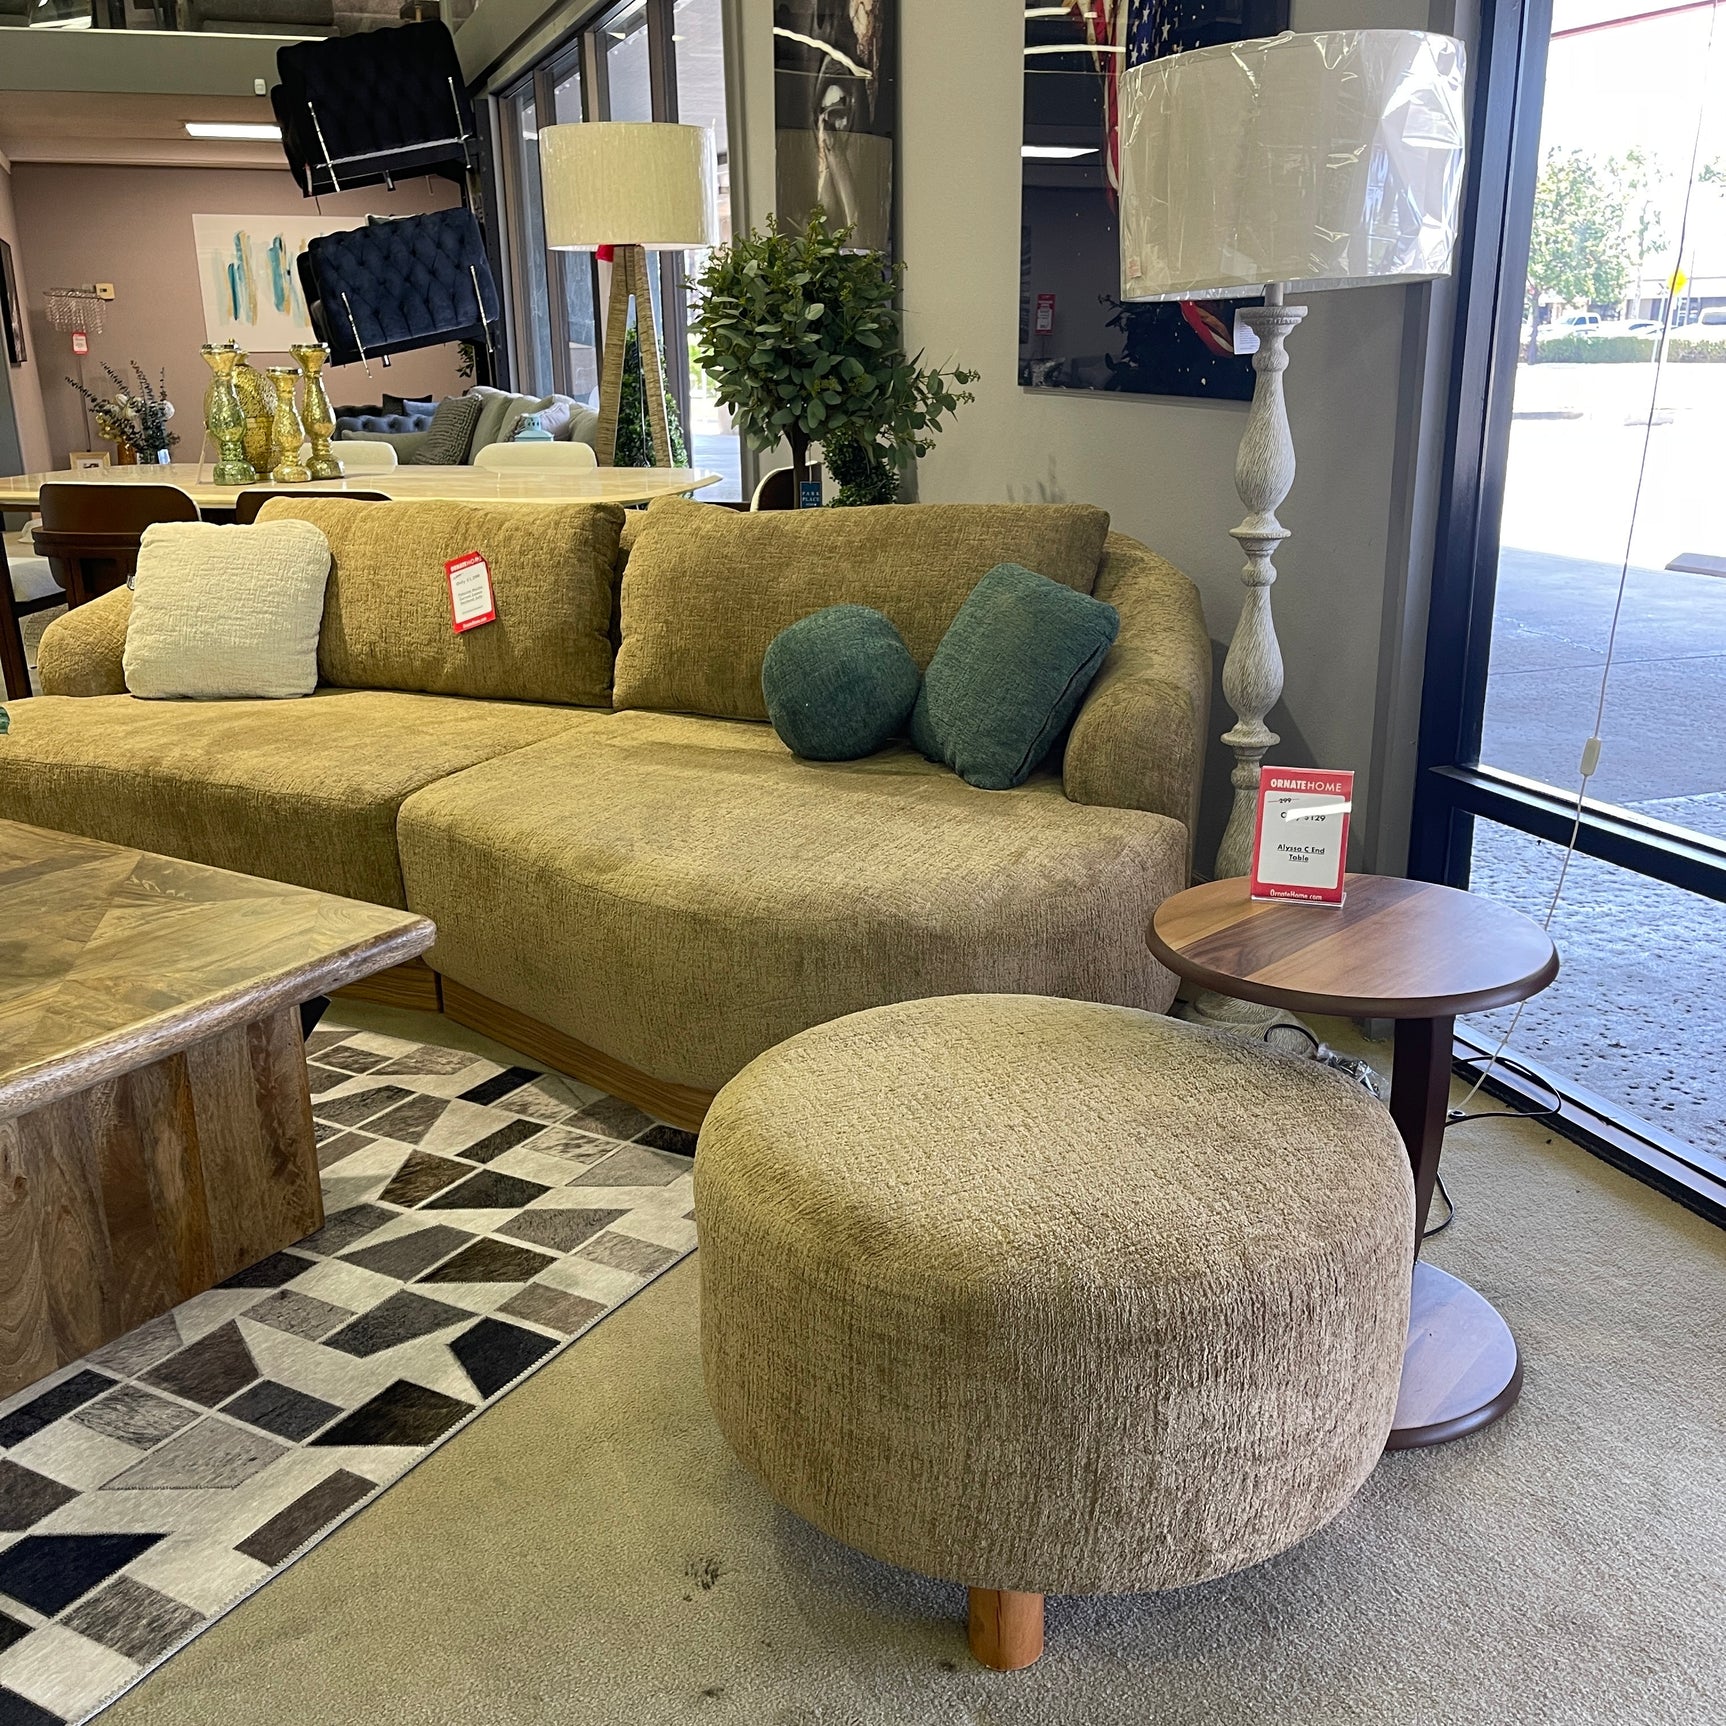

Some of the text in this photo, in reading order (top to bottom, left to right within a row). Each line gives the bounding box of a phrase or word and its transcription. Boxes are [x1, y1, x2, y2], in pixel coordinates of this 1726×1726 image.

[1270, 778, 1342, 792] ORNATEHOME
[1277, 844, 1302, 852] Alyssa
[1311, 846, 1325, 855] End
[1289, 854, 1309, 862] Table
